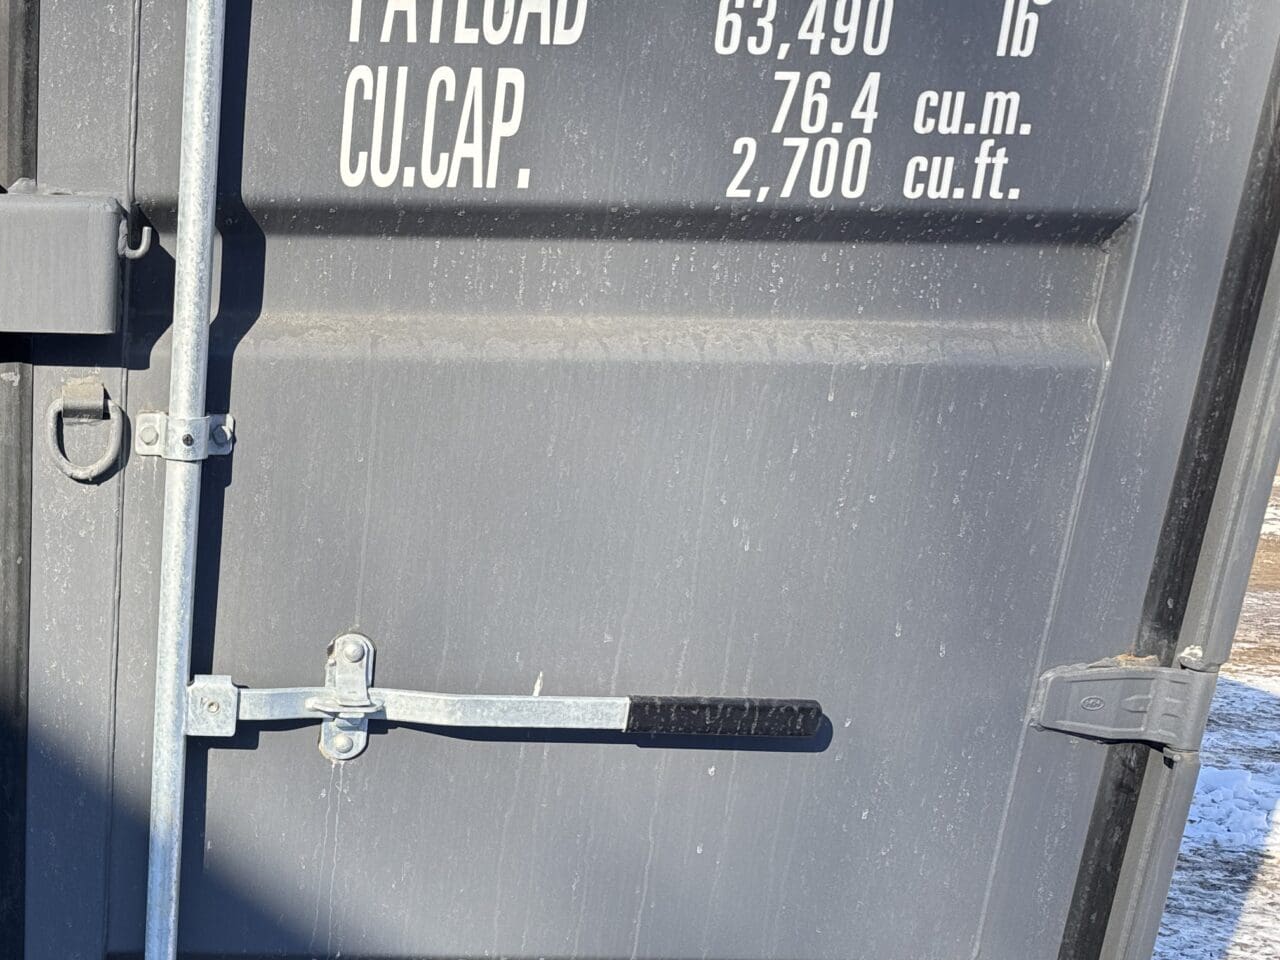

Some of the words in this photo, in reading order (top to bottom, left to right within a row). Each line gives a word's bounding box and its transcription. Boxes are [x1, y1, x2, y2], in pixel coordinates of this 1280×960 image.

[714, 0, 895, 60] 63,490
[340, 64, 531, 189] CU.CAP.
[771, 71, 881, 134] 76.4
[913, 90, 1032, 136] cu.m.
[725, 136, 872, 203] 2,700
[903, 138, 1021, 200] cu.ft.
